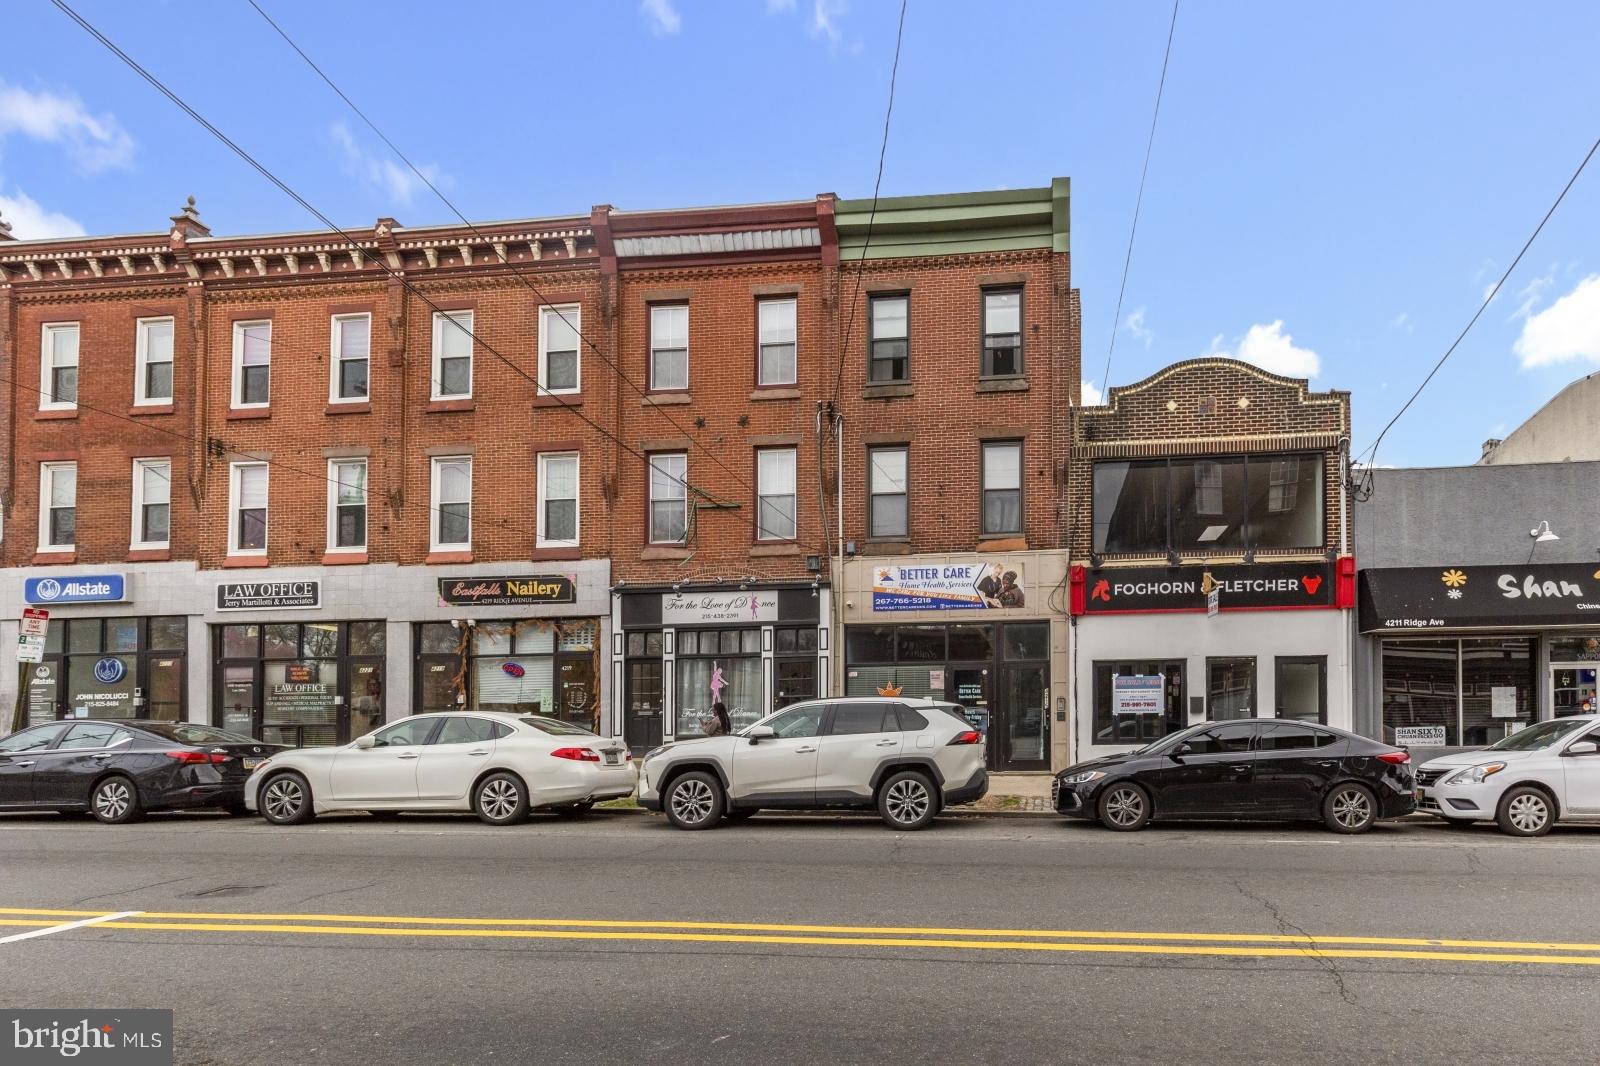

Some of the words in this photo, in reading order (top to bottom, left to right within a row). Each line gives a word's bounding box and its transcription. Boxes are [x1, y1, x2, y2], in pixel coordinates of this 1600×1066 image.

[900, 568, 938, 580] BETTER
[943, 567, 971, 579] CARE
[61, 581, 111, 596] Allstate
[224, 584, 257, 597] LAW
[260, 583, 313, 596] OFFICE
[506, 581, 562, 598] Nailery
[921, 581, 945, 589] Health
[945, 580, 973, 590] Services
[1114, 582, 1195, 596] FOGHORN
[1216, 579, 1299, 593] FLETCHER
[1497, 574, 1584, 599] Shan
[224, 600, 240, 608] Jerry
[664, 598, 685, 610] For
[685, 600, 698, 610] the
[700, 596, 725, 610] Love
[724, 600, 734, 612] of
[734, 596, 776, 609] Dnce
[1385, 619, 1403, 627] 4211
[1403, 618, 1428, 628] Ridge
[275, 684, 294, 692] LAW
[295, 684, 327, 692] OFFICE
